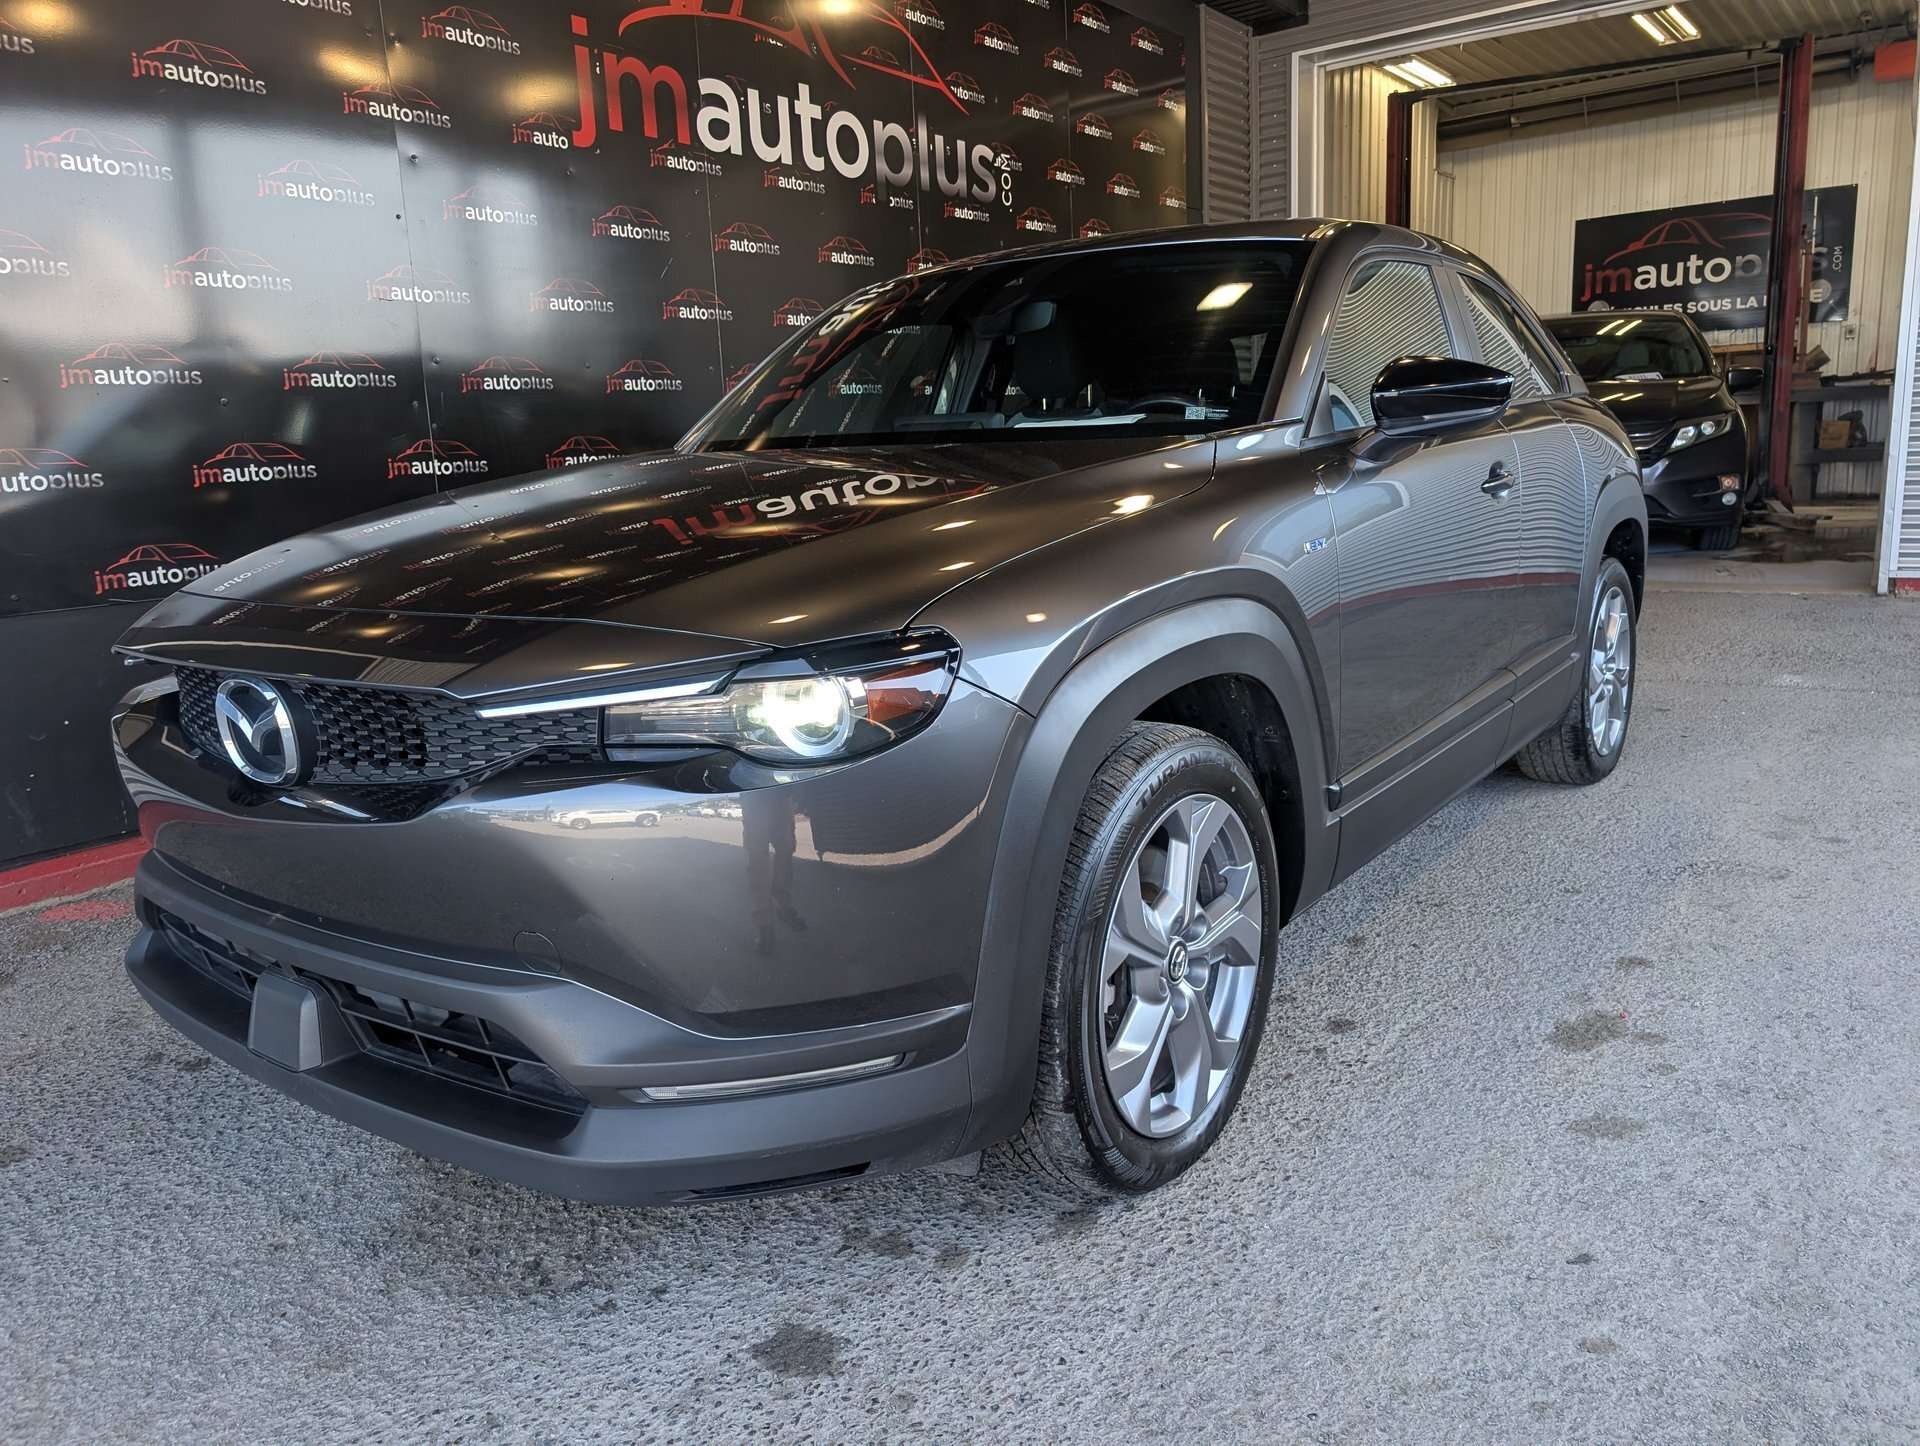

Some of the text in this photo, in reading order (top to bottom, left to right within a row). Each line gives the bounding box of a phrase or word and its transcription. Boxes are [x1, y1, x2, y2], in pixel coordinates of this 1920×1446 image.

[421, 17, 521, 55] jmautoplus
[131, 52, 267, 95] jmautoplus
[343, 91, 451, 129] jmautoplus
[570, 14, 997, 204] jmautoplus
[24, 144, 173, 182] jmautoplus
[650, 149, 722, 177] jmautoplus
[257, 174, 375, 207] jmautoplus
[763, 170, 826, 194] jmautoplus
[592, 217, 671, 242] jmautoplus
[714, 233, 780, 256] jmautoplus
[818, 247, 875, 267] jmautoplus
[163, 264, 292, 292] jmautoplus
[529, 291, 615, 314] jmautoplus
[662, 301, 733, 321] jmautoplus
[1687, 299, 1732, 313] SOUS
[1736, 296, 1760, 309] LA
[60, 363, 202, 390] jmautoplus
[283, 368, 397, 390] jmautoplus
[461, 373, 554, 396] jmautoplus
[606, 375, 683, 394] jmautoplus
[193, 464, 317, 488] jmautoplus
[387, 456, 489, 480] jmautoplus
[0, 471, 104, 493] utoplus
